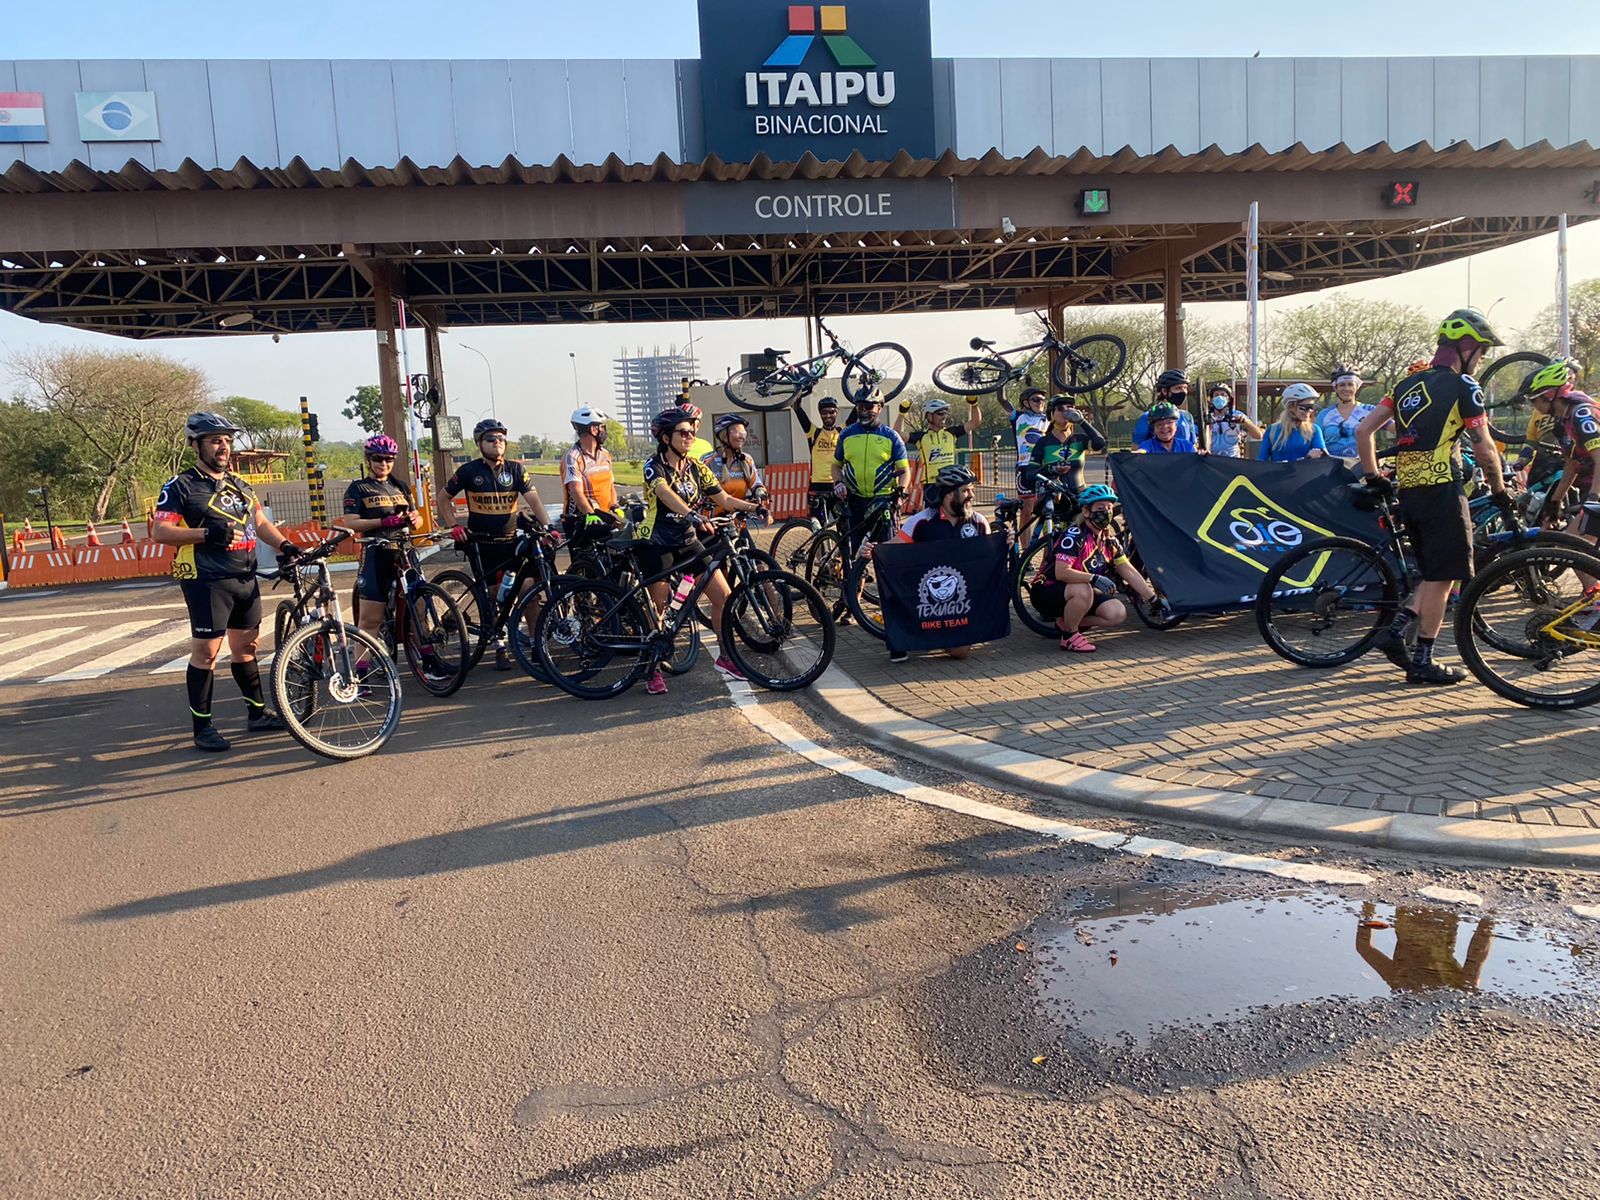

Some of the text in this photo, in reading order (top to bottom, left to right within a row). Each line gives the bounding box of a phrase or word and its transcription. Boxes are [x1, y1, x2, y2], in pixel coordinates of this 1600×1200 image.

[746, 71, 896, 106] ITAIPU
[755, 114, 888, 136] BINACIONAL
[754, 193, 892, 218] CONTROLE
[916, 599, 972, 618] TEXUGOS
[921, 617, 968, 629] BIKE TEAM
